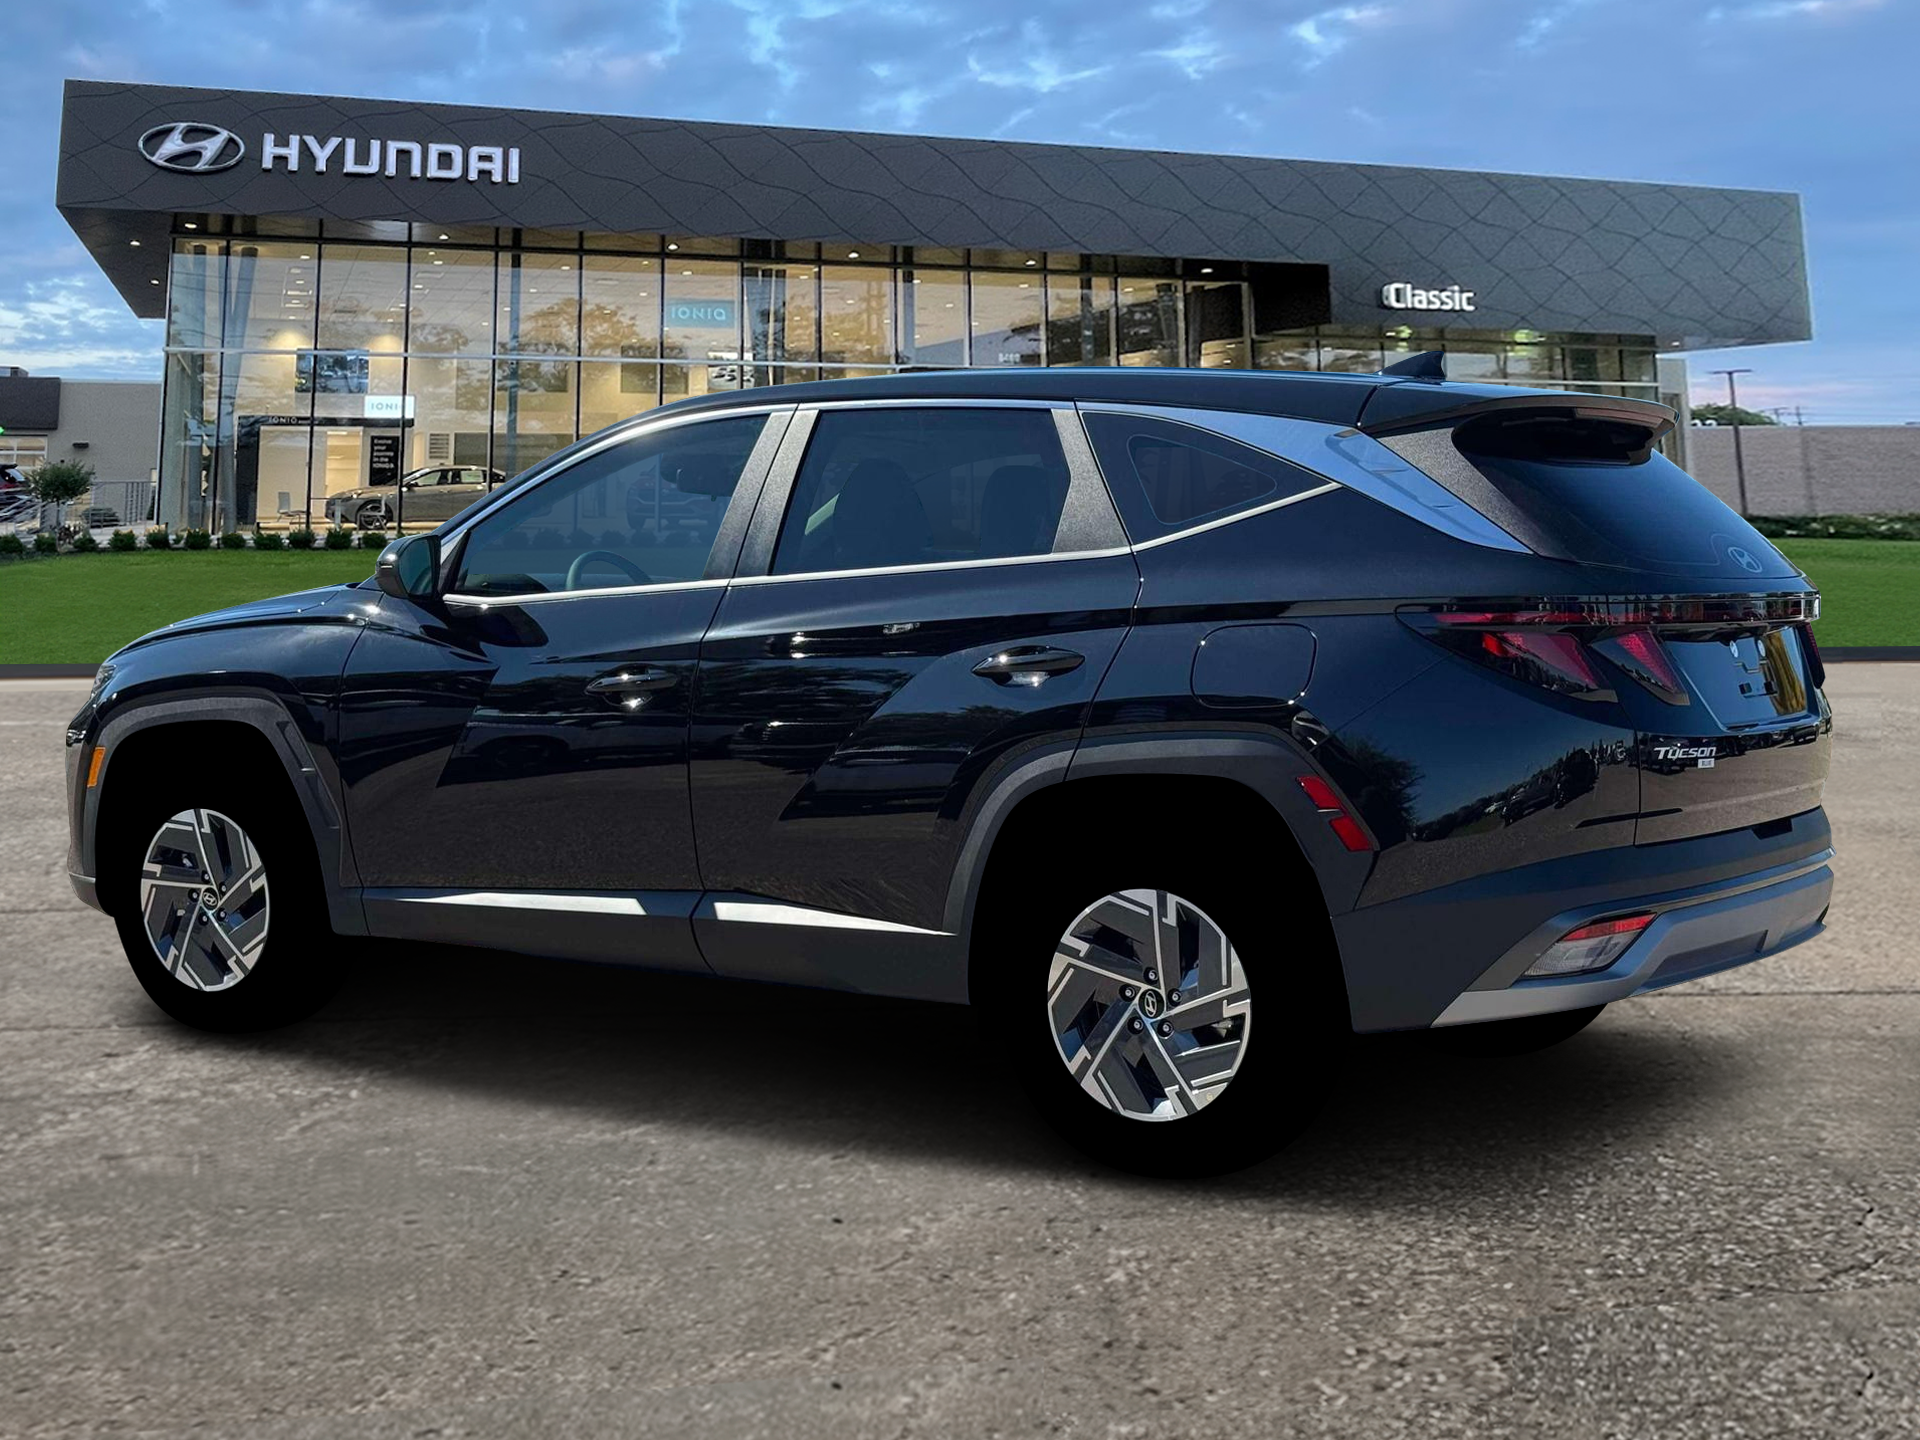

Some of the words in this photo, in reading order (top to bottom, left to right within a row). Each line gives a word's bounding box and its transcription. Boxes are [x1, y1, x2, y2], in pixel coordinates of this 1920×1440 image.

[261, 132, 521, 185] HYUNDAI
[1382, 282, 1476, 312] Classic
[671, 306, 727, 321] IONIQ
[370, 401, 404, 411] IONI
